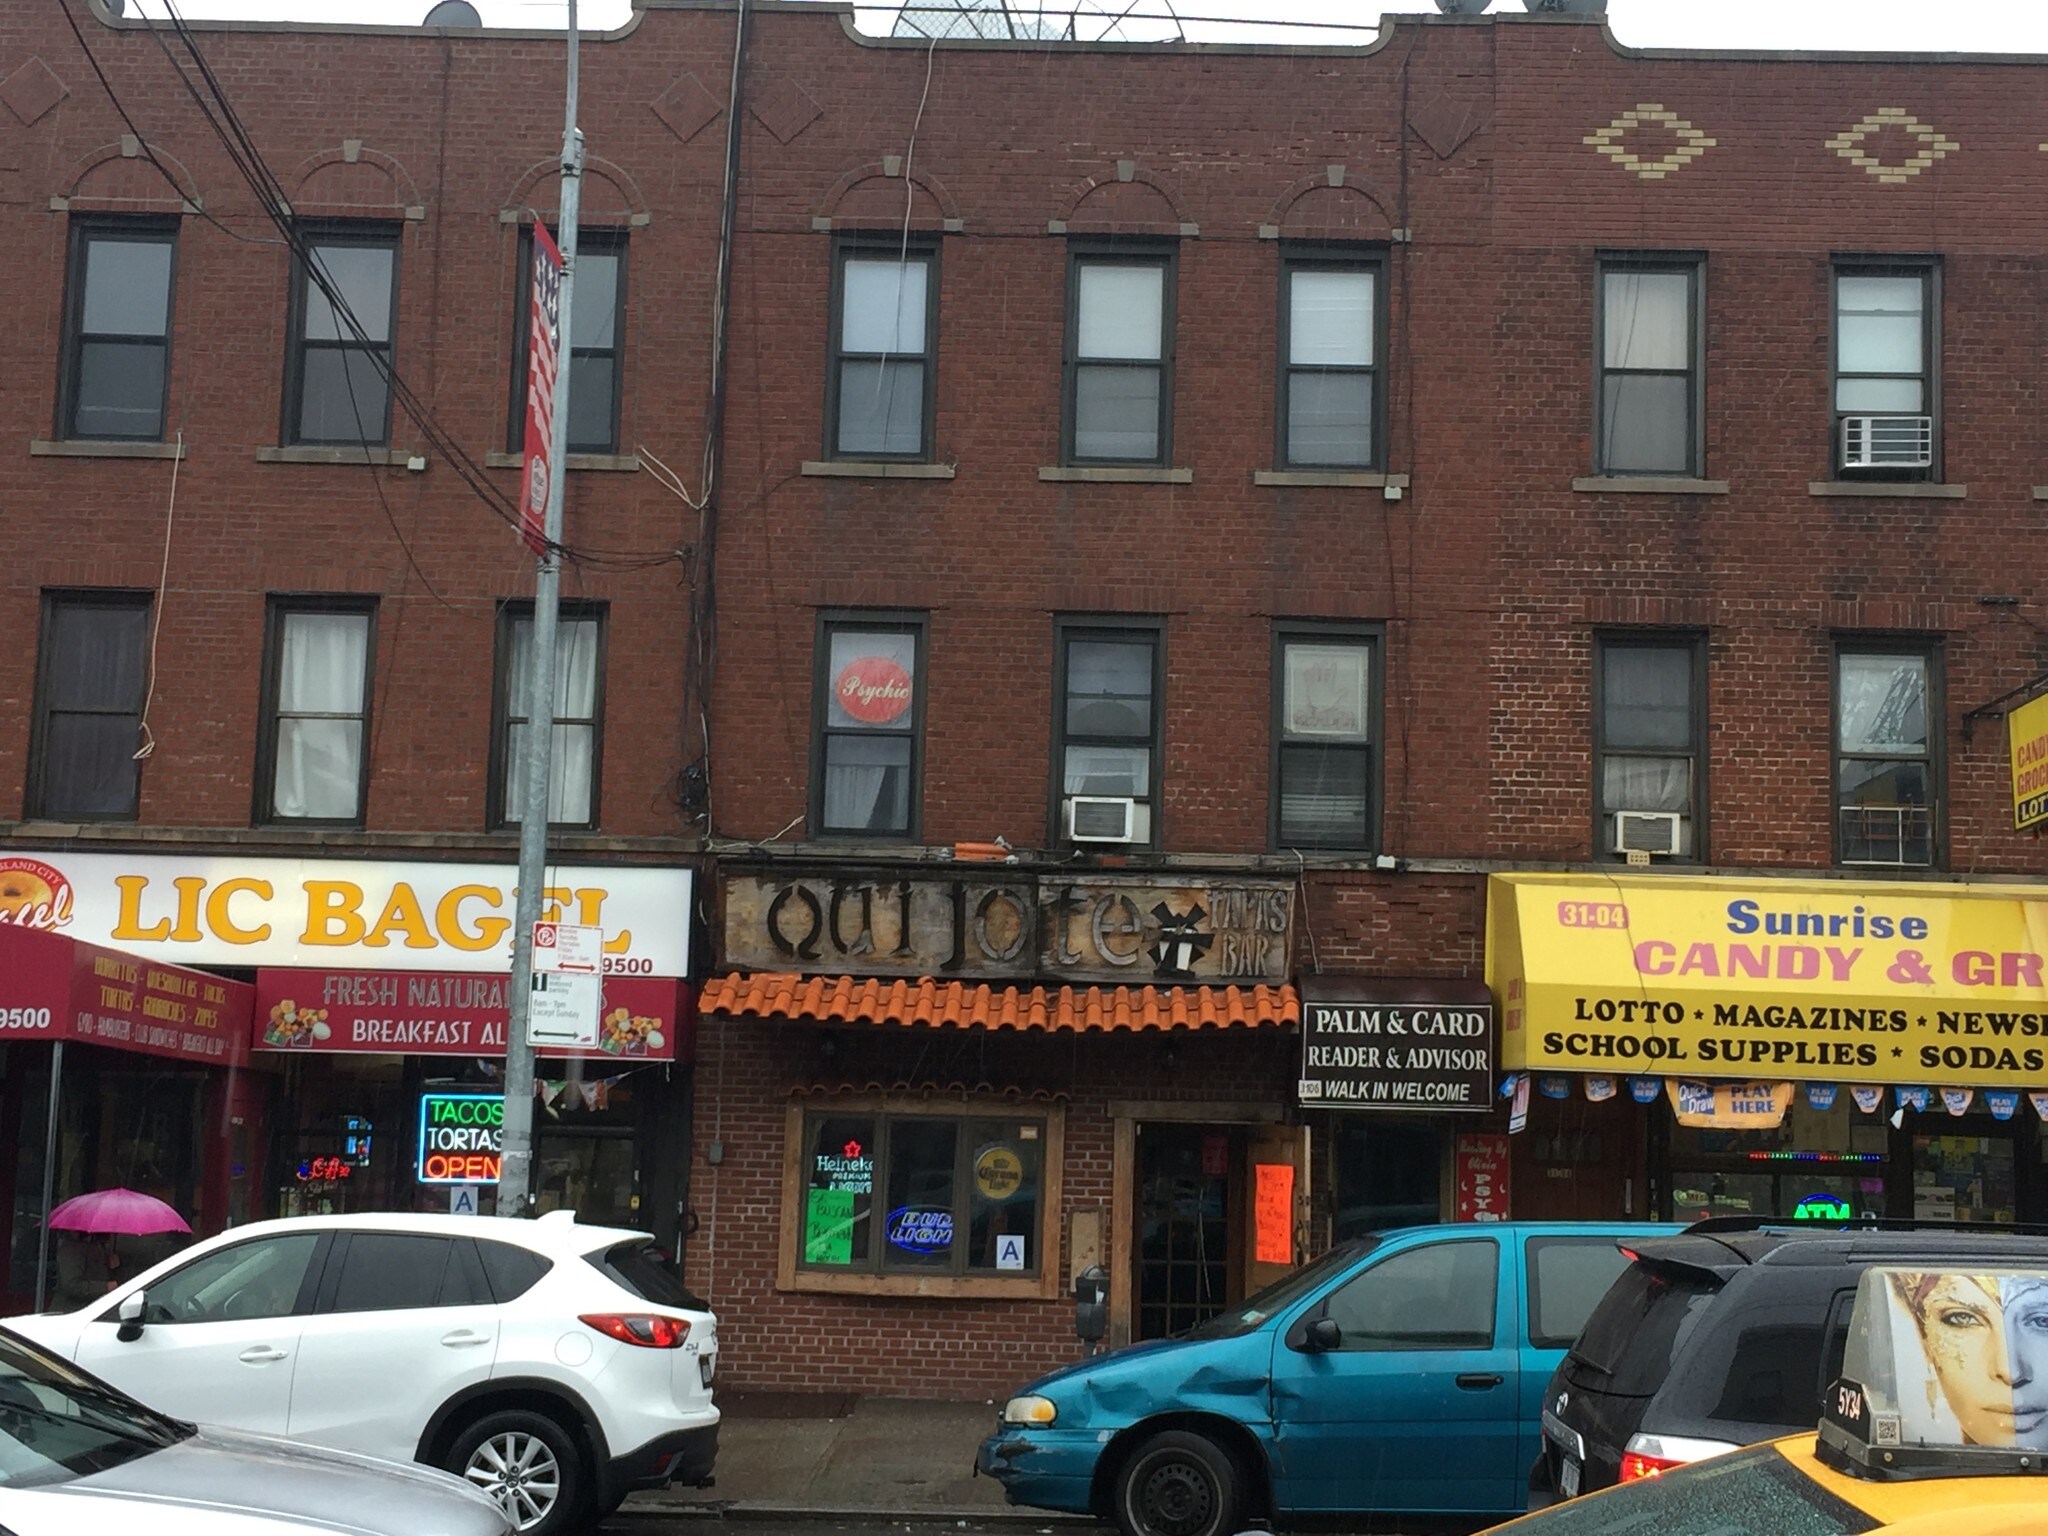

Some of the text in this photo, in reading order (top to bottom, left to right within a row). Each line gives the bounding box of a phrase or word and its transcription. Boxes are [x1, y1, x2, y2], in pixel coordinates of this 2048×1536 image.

[842, 676, 909, 706] Psychic
[2017, 733, 2048, 769] CAND
[2017, 761, 2048, 797] GROC
[2021, 793, 2048, 821] LOT
[37, 866, 62, 884] CITY
[111, 876, 273, 945] LIC
[1564, 903, 1625, 928] 31-04
[1726, 899, 1929, 940] Sunrise
[1221, 934, 1268, 976] BAR
[1633, 940, 2044, 987] CANDY & GR
[323, 976, 398, 1007] FRESH
[1316, 1010, 1381, 1034] PALM
[1386, 1010, 1408, 1035] &
[1411, 1010, 1485, 1037] CARD
[1575, 998, 1685, 1024] LOTTO
[1713, 1003, 1908, 1033] MAGAZINES
[353, 1019, 472, 1045] BREAKFAST
[1308, 1046, 1488, 1071] READER & ADVISOR
[1544, 1032, 2044, 1071] SCHOOL SUPPLIES SODAS
[1325, 1081, 1470, 1101] WALK IN WELCOME
[1679, 1084, 1709, 1102] Quick
[1731, 1084, 1773, 1099] PLAY
[430, 1101, 504, 1125] TACOS
[1688, 1098, 1716, 1115] Draw
[1732, 1100, 1775, 1114] HERE
[426, 1154, 501, 1179] OPEN
[455, 1191, 472, 1212] A
[1794, 1203, 1849, 1219] ATM
[1002, 1240, 1020, 1261] A
[1838, 1386, 1861, 1420] 5Y34
